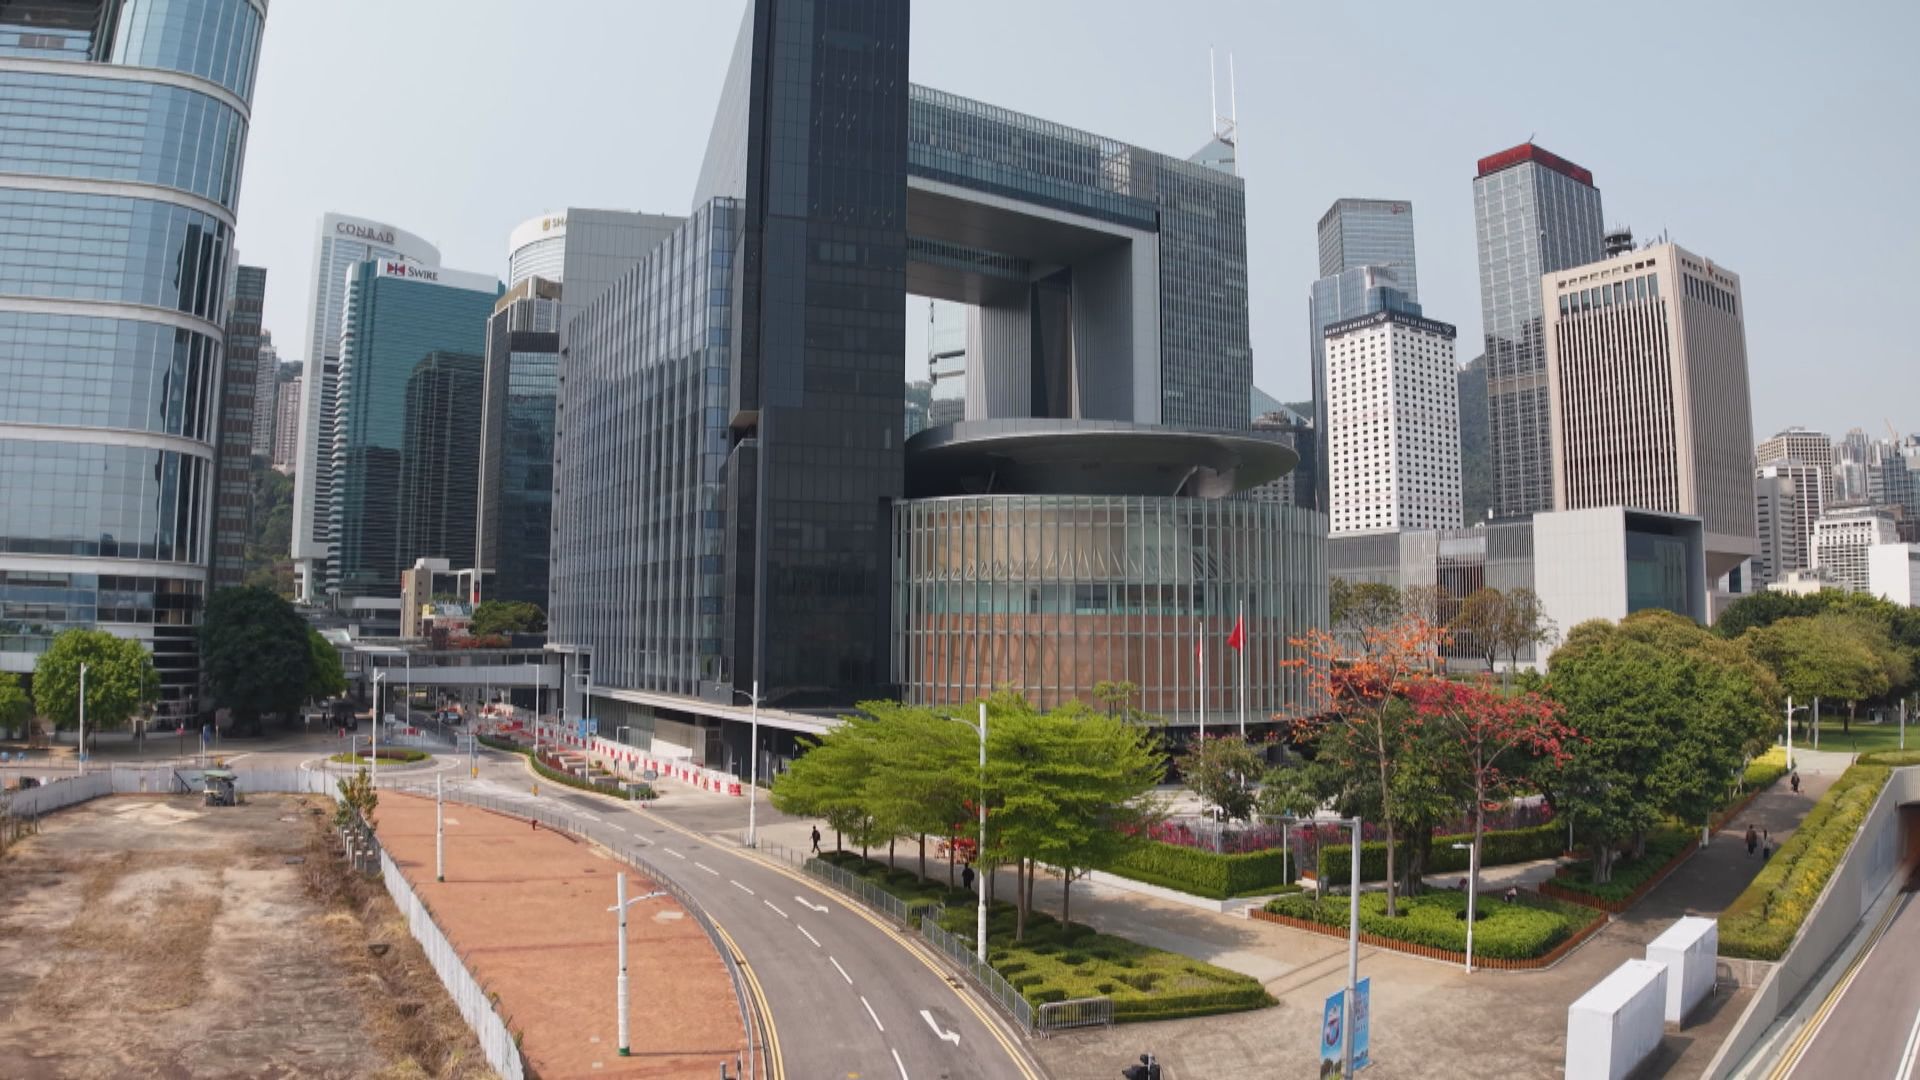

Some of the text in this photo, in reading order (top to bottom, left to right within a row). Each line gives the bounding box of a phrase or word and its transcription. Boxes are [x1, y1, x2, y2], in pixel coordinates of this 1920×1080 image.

[336, 222, 395, 245] CONRAD
[1325, 326, 1340, 336] BANK
[1348, 317, 1374, 329] AMERICA
